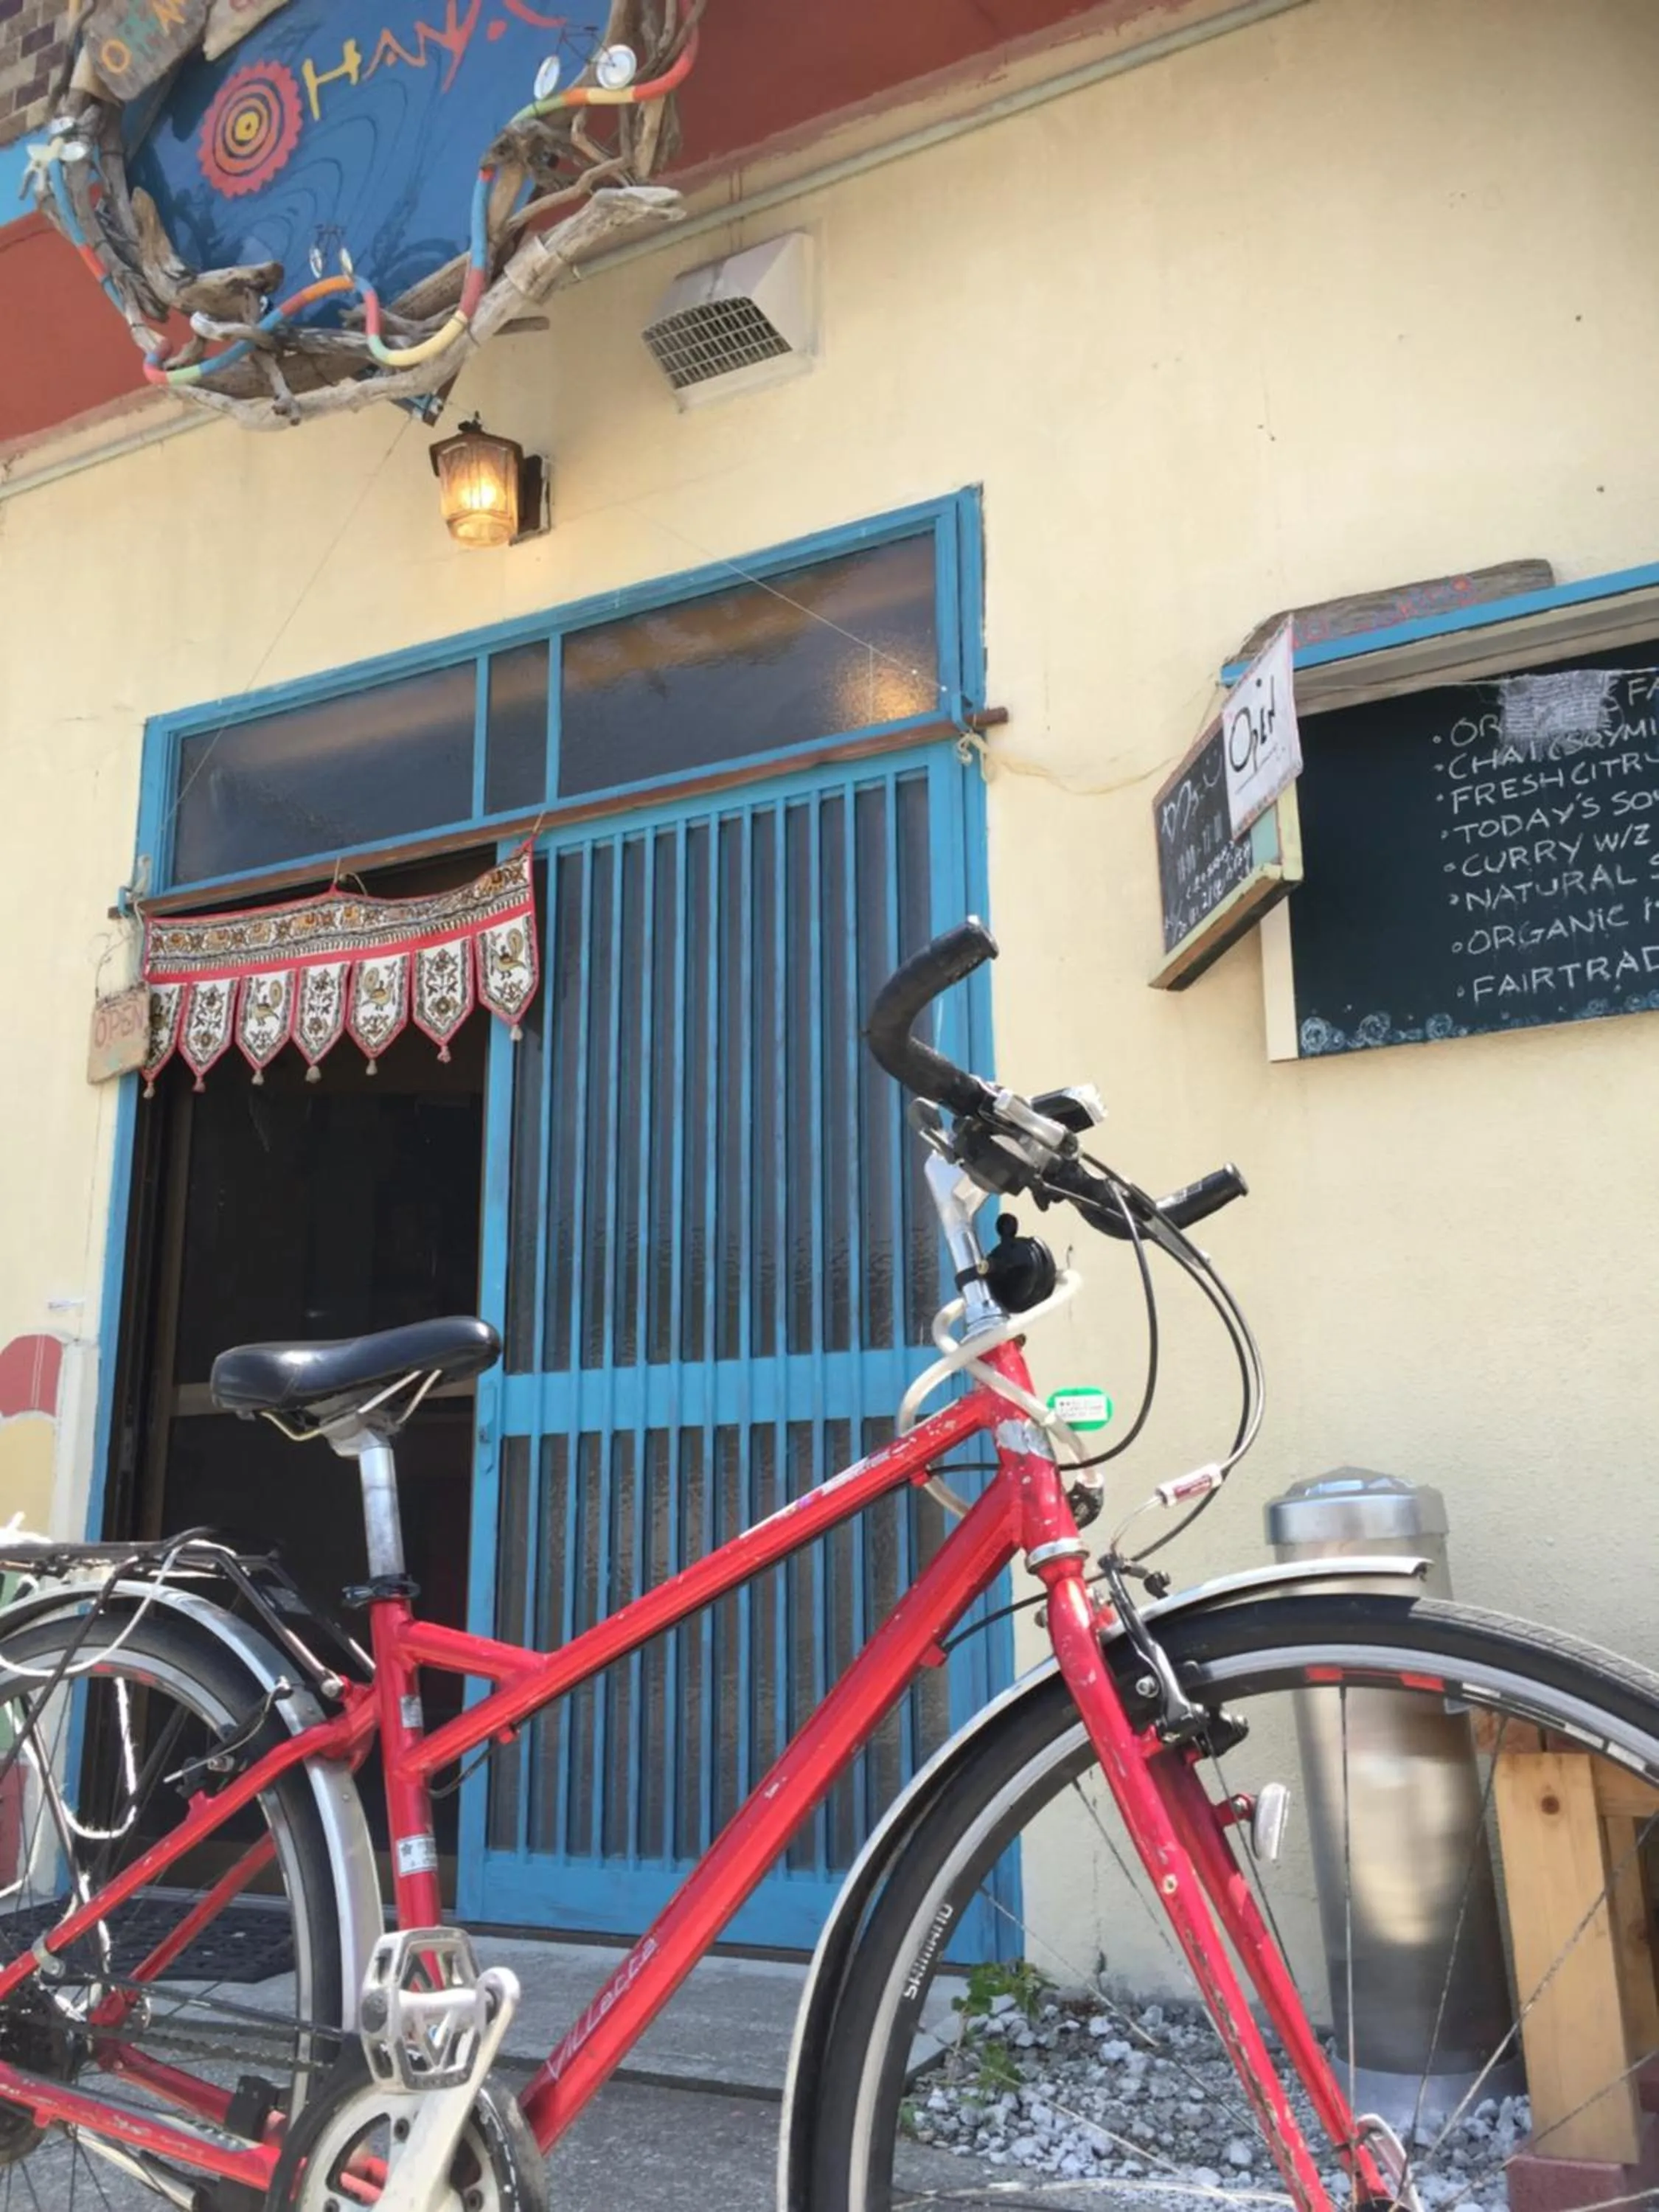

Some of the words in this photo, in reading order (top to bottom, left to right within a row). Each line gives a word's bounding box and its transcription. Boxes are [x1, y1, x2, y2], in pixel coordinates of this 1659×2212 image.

[1448, 740, 1537, 779] CHAI
[1450, 773, 1564, 815] FRESH
[1453, 792, 1601, 844] TODAY'S
[1461, 832, 1583, 877] CURRY
[1465, 863, 1638, 911] NATURAL
[903, 1903, 953, 2000] SHIMANO
